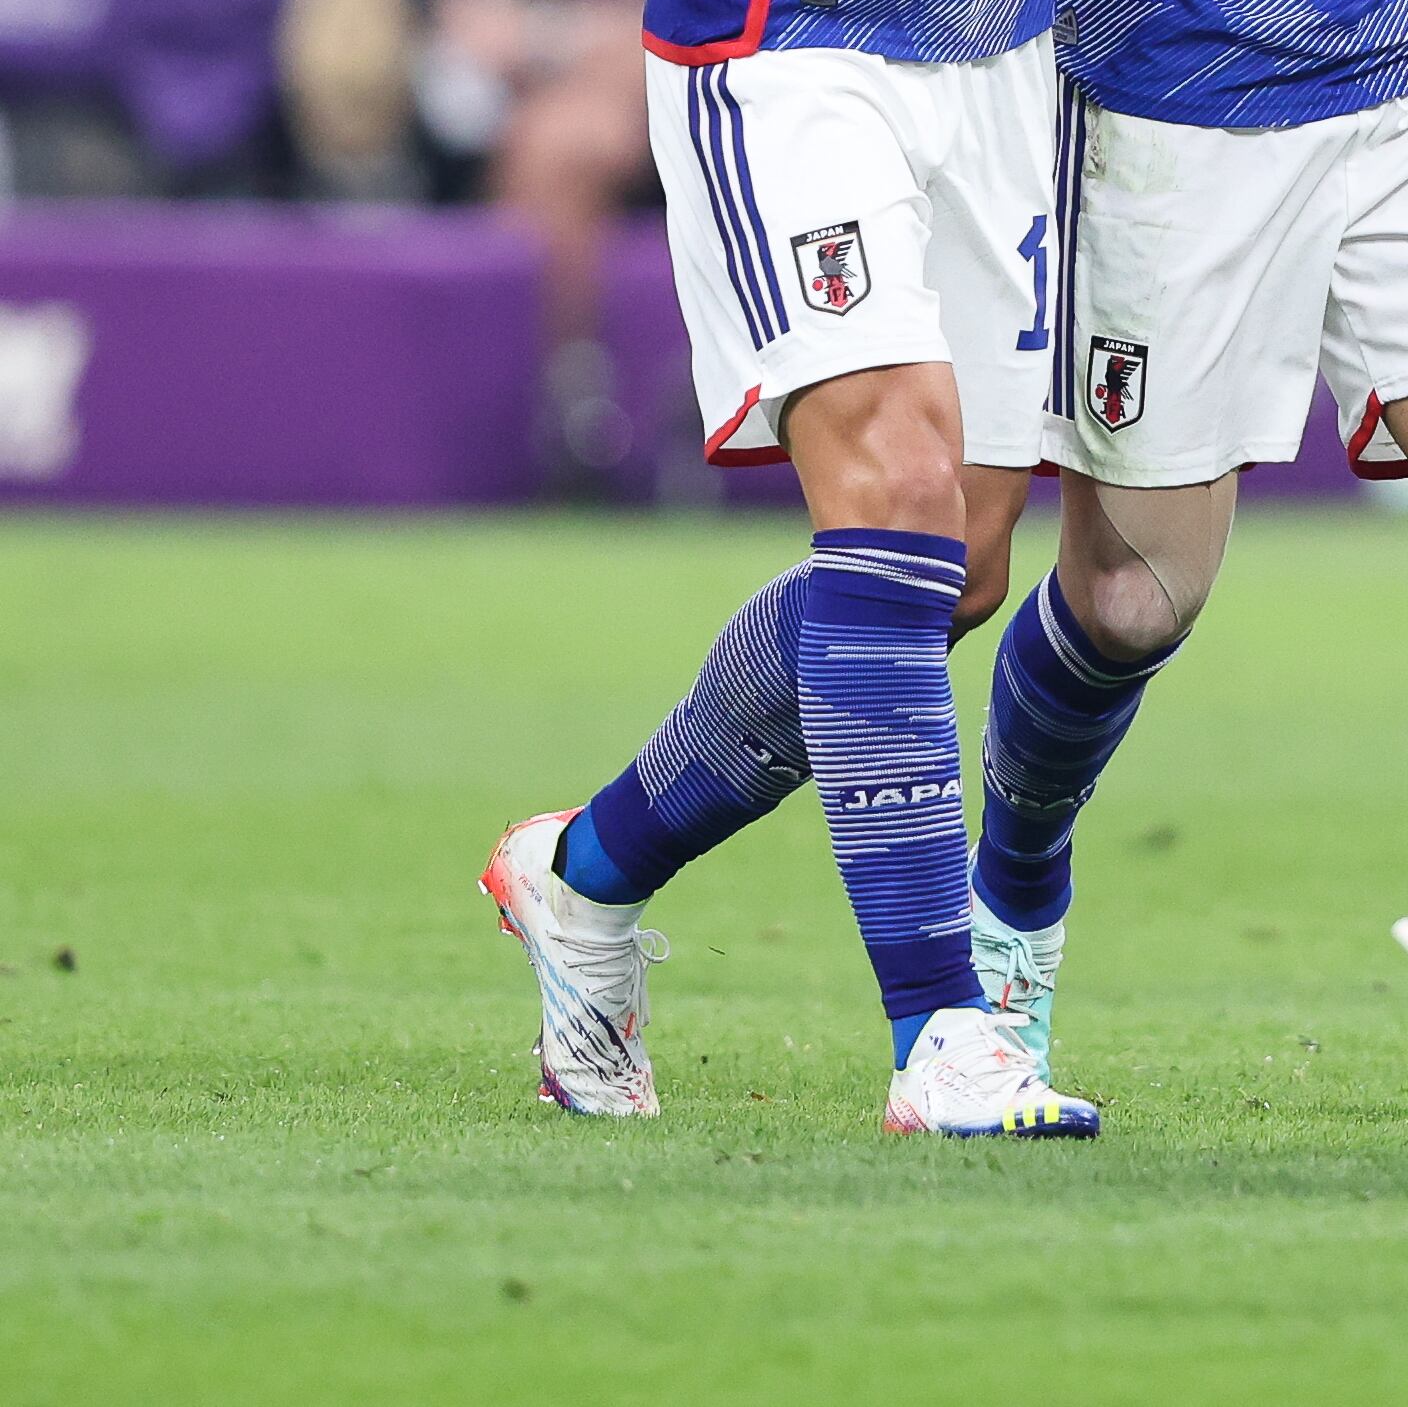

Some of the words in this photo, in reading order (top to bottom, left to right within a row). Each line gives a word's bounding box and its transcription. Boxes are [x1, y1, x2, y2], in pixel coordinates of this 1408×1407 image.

[805, 225, 845, 243] JAPAN
[1103, 340, 1135, 353] JAPAN
[845, 777, 963, 809] JAPA
